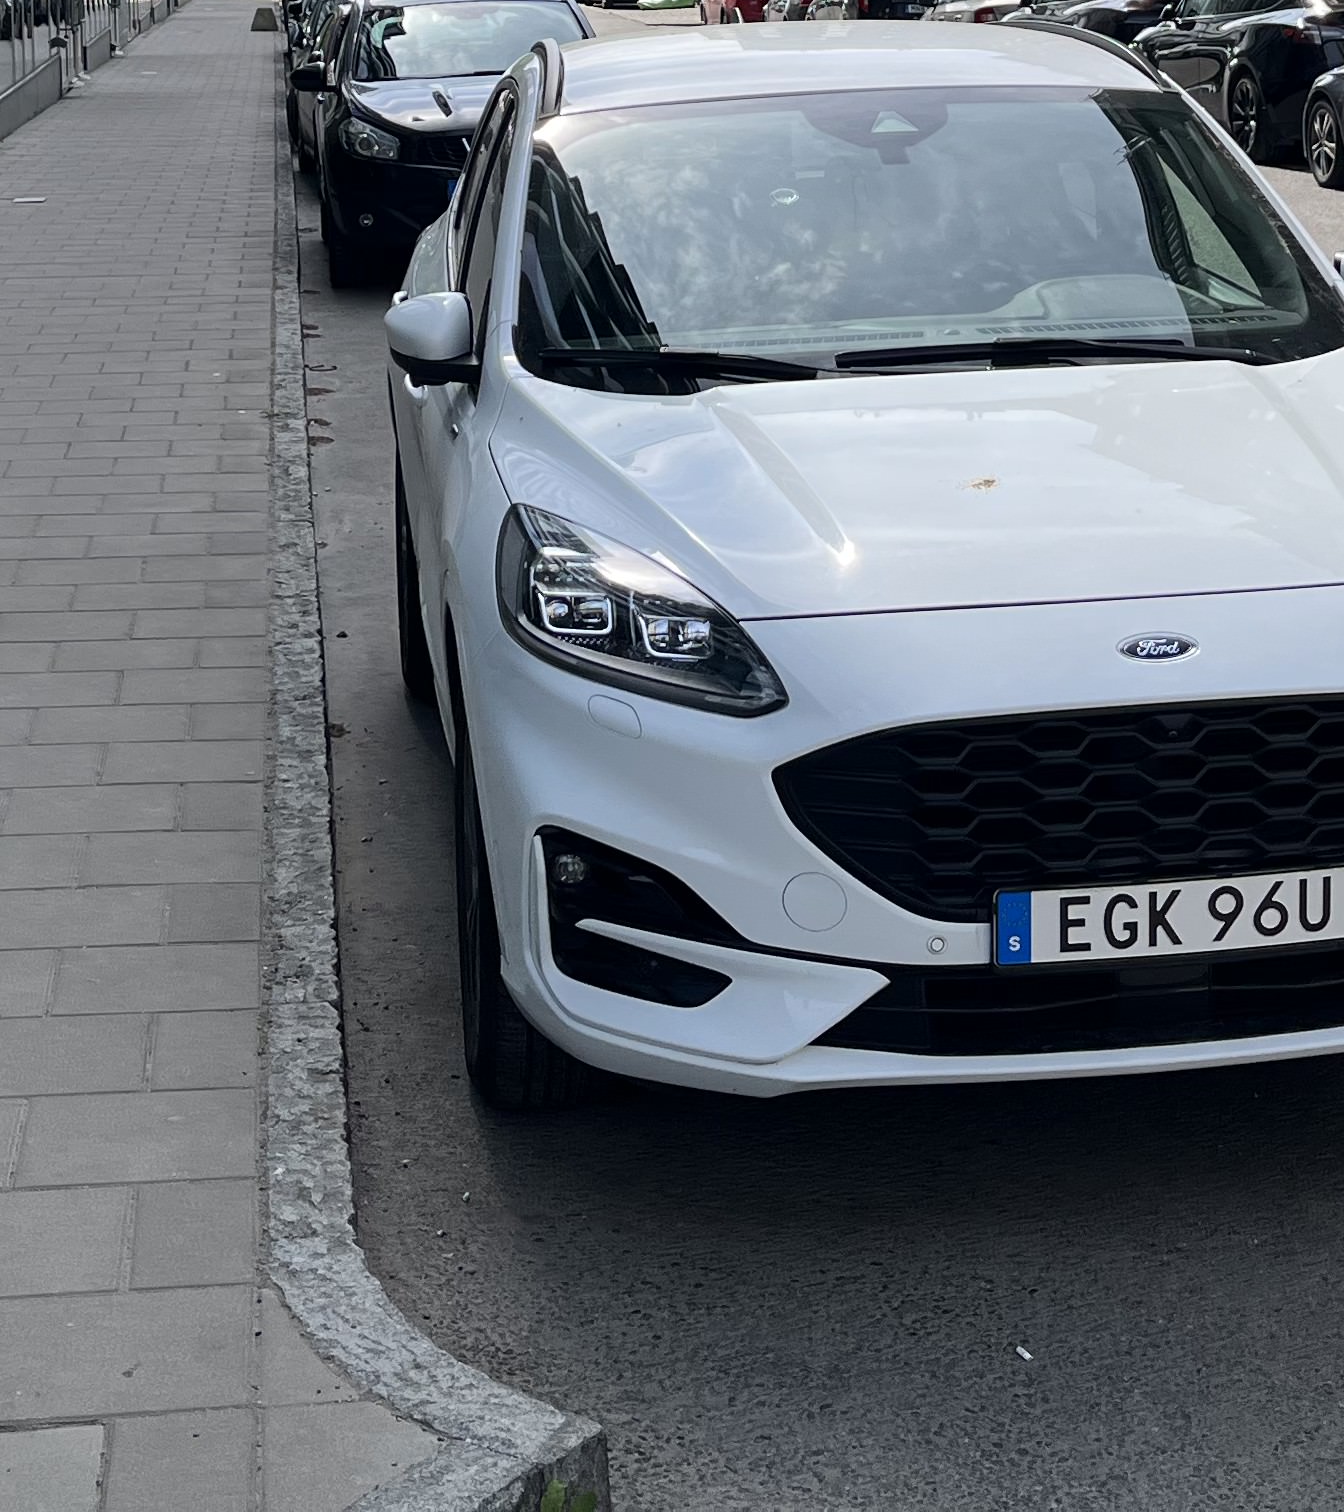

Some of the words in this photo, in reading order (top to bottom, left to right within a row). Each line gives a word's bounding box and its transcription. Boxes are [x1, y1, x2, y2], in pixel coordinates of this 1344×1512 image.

[1136, 638, 1180, 656] Ford
[1059, 889, 1183, 953] EGK
[1207, 875, 1331, 942] 96U
[1007, 935, 1022, 952] S
